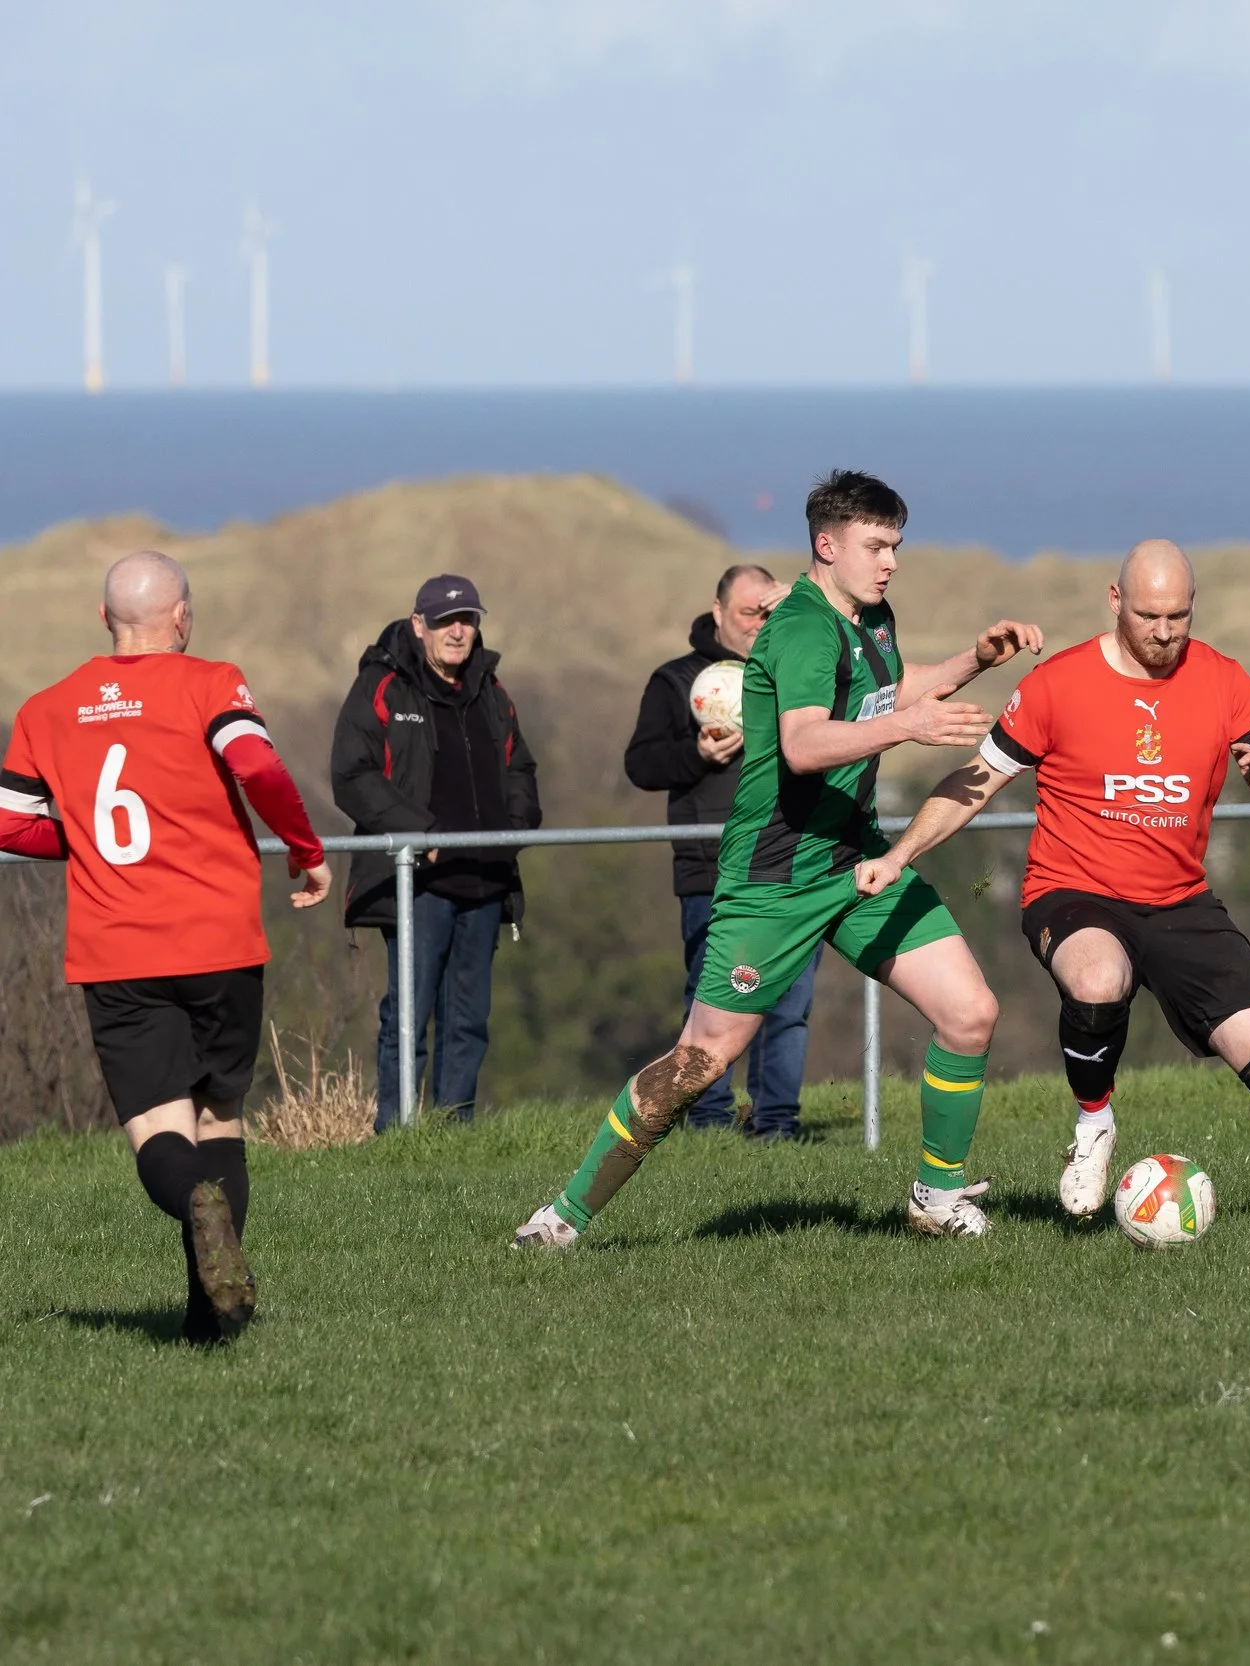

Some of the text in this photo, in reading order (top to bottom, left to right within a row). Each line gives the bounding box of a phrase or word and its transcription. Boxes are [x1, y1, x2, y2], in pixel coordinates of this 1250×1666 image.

[78, 700, 143, 715] RG HOWELLS
[78, 709, 142, 723] cleaning services
[1103, 773, 1191, 804] PSS
[94, 743, 150, 865] 6
[1100, 809, 1189, 828] AUTO CENTRE
